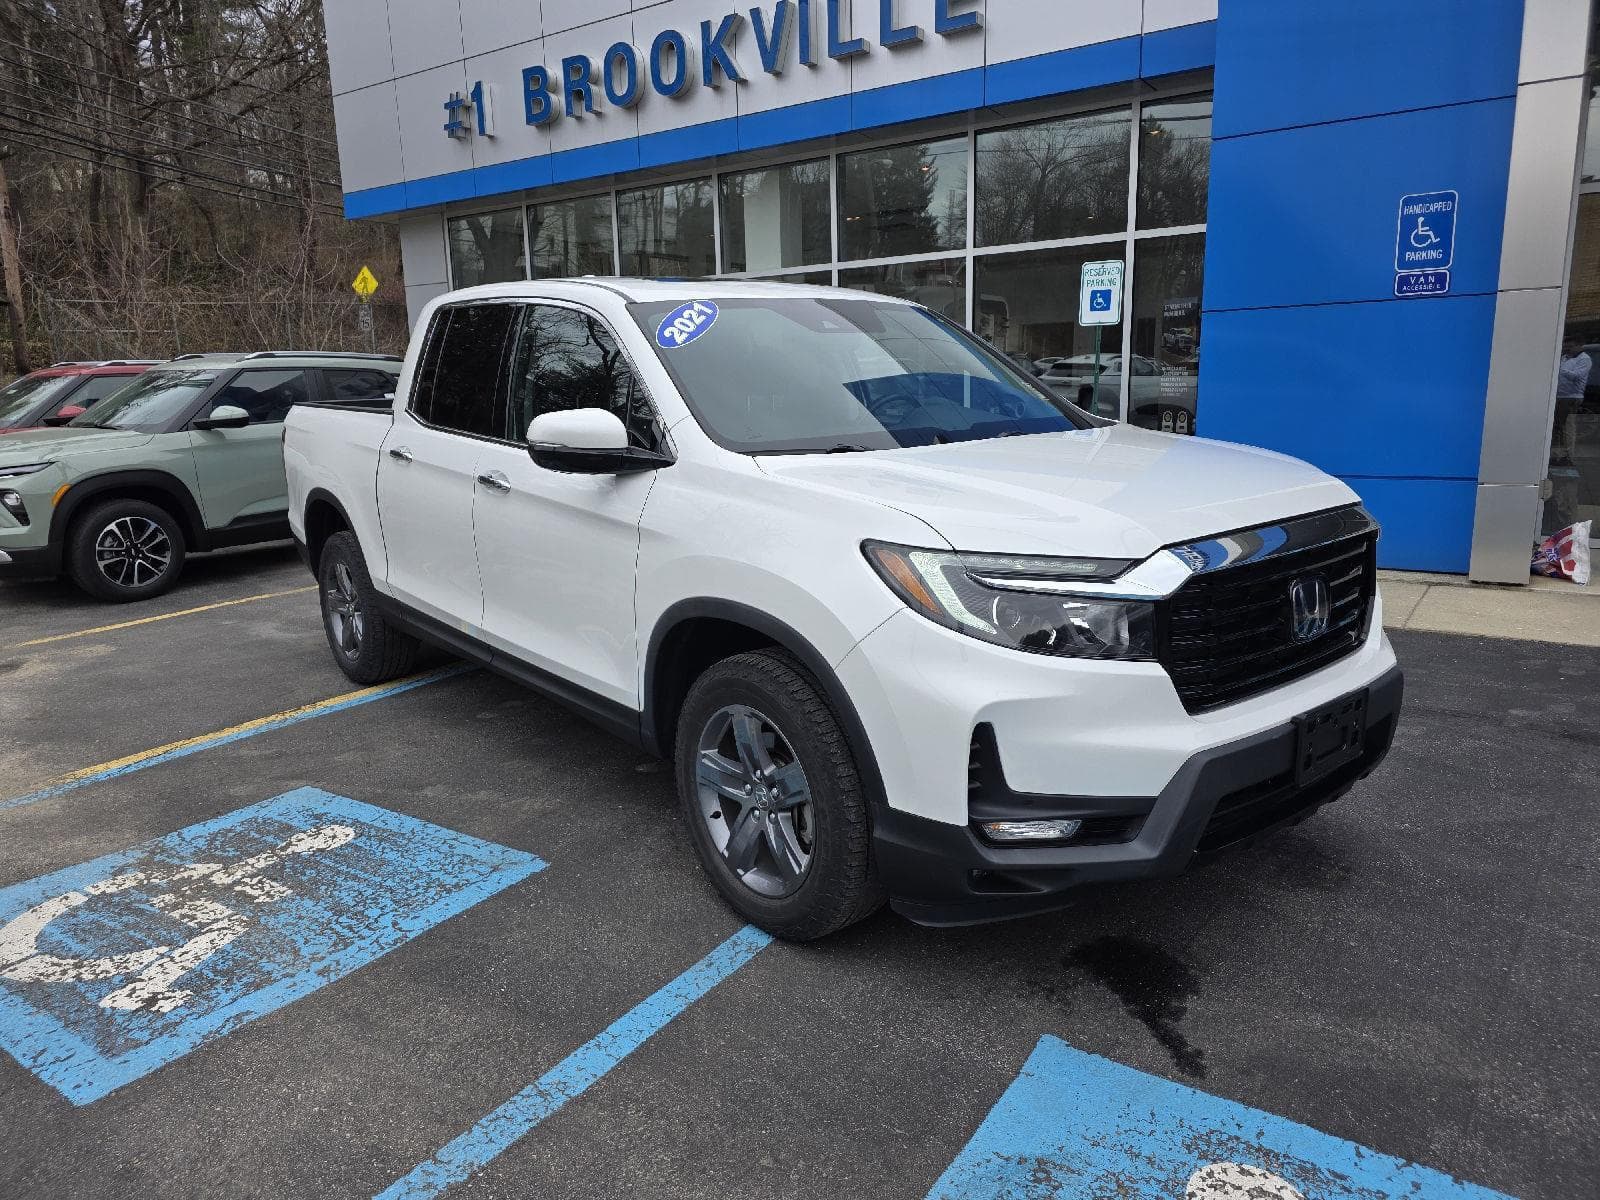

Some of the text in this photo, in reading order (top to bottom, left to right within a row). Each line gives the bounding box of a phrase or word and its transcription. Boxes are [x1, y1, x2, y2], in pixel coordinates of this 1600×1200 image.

[443, 80, 493, 138] #1
[1403, 201, 1453, 215] HANDICAPPED
[1405, 249, 1443, 261] PARKING
[1084, 266, 1121, 276] RESERVED
[1086, 277, 1117, 287] PARKING
[1410, 275, 1435, 284] VAN
[663, 302, 714, 344] 2021
